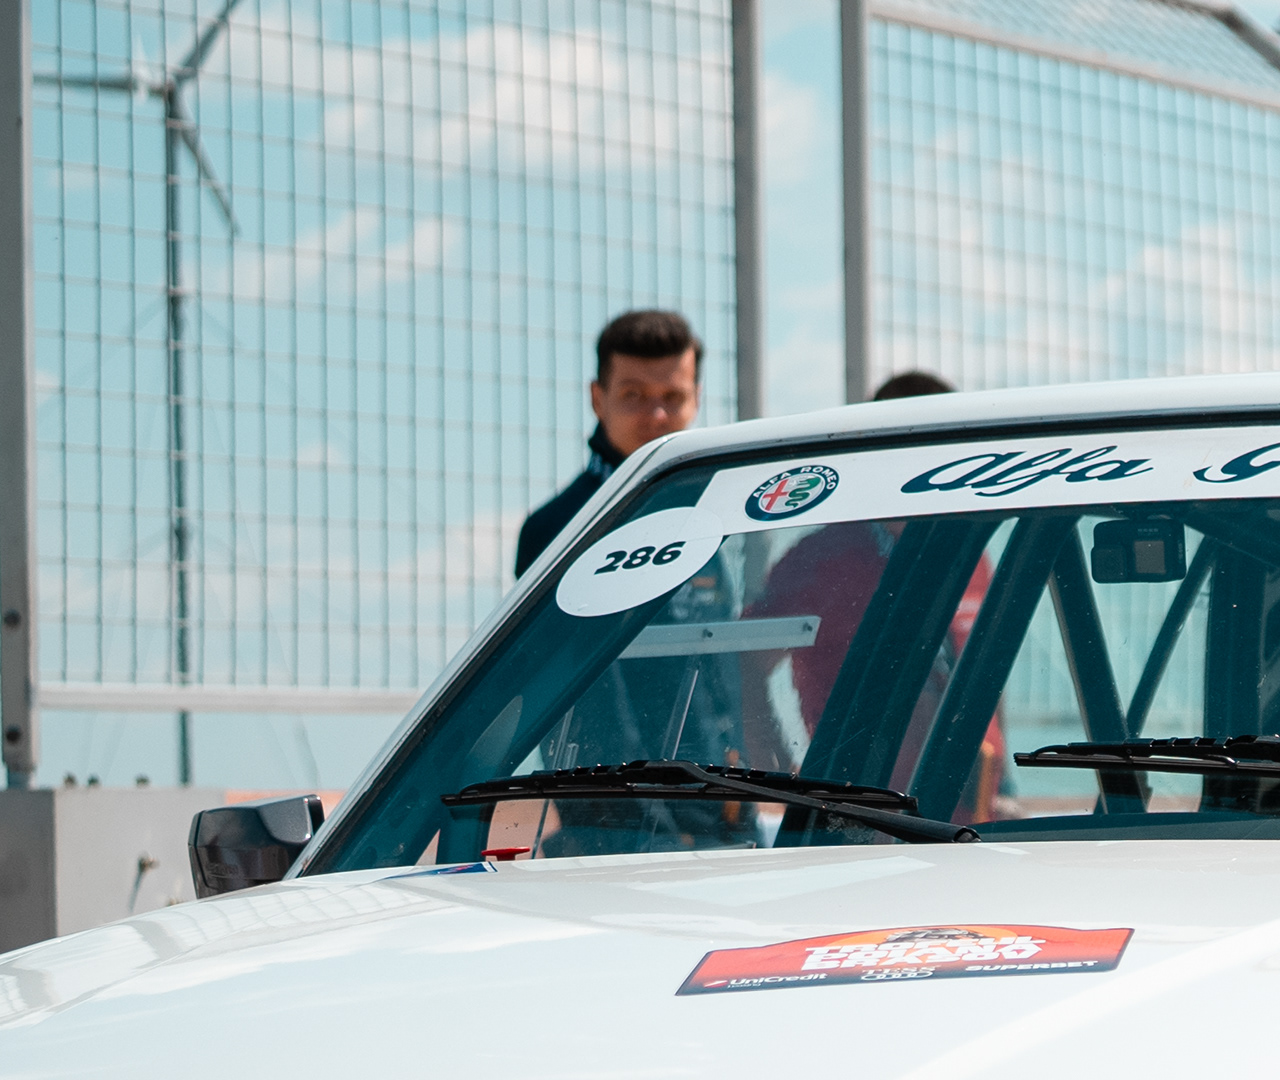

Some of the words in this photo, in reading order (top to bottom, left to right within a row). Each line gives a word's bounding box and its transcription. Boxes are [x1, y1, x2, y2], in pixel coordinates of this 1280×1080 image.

[900, 445, 1154, 497] Alfa
[752, 471, 791, 499] ALFA
[800, 465, 838, 490] ROMEO
[594, 540, 687, 576] 286
[803, 943, 1044, 963] POIANA
[805, 936, 1046, 955] TROFEUL
[964, 960, 1098, 972] SUPERBET
[730, 973, 827, 985] UniCredit
